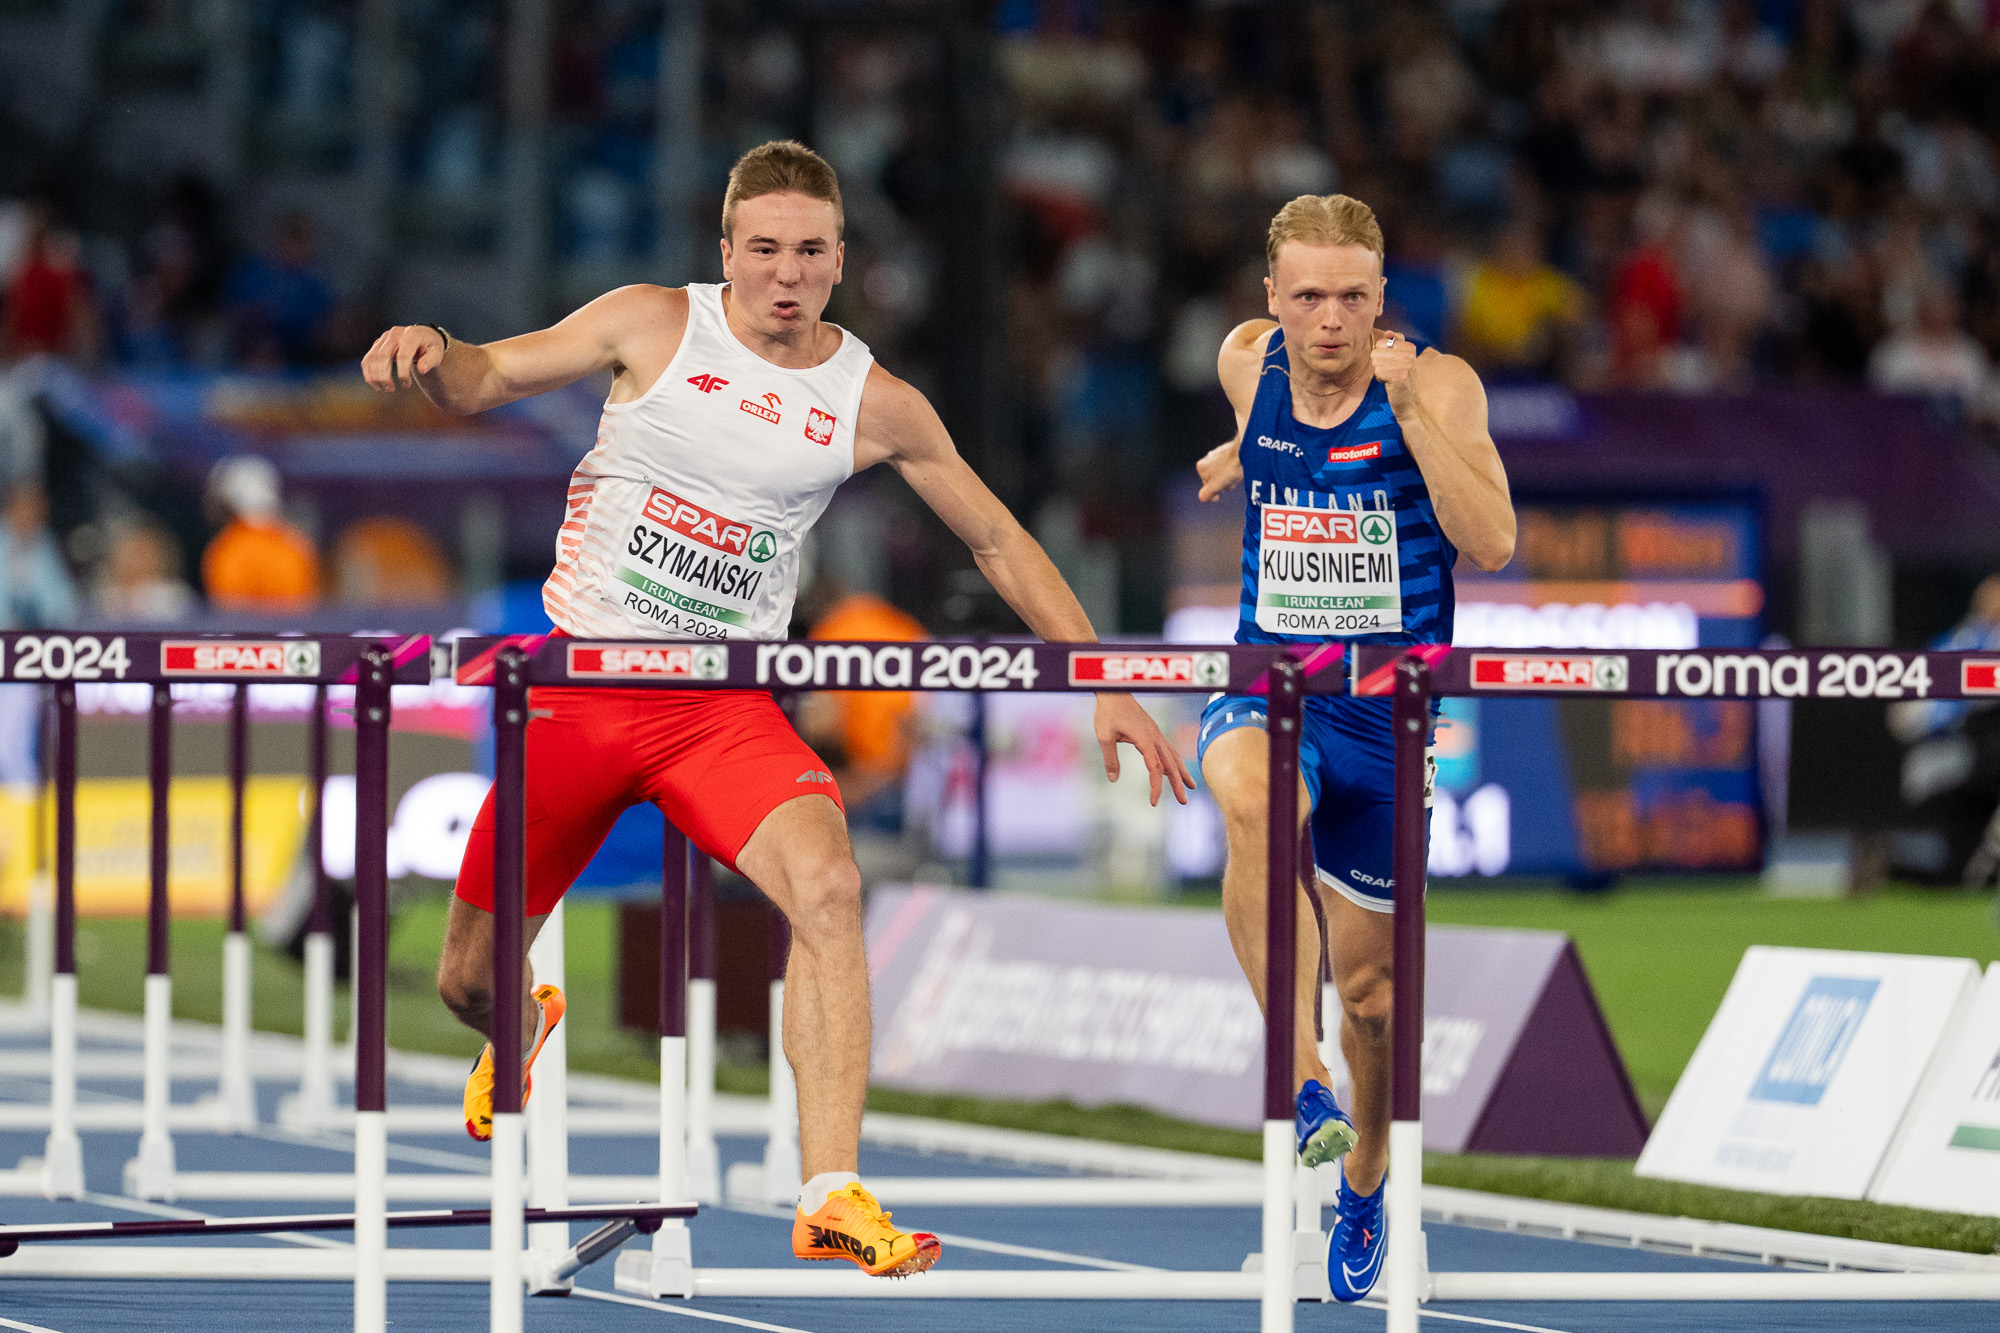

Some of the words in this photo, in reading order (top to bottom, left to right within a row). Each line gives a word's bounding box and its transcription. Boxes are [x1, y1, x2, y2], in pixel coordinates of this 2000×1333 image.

[687, 373, 730, 393] 4F
[742, 402, 780, 423] ORLEN
[1257, 435, 1297, 455] CRAFT
[1330, 445, 1379, 461] motonet
[646, 492, 748, 551] SPAR
[1265, 512, 1356, 540] SPAR
[628, 525, 763, 601] SZYMAŃSKI
[1263, 549, 1393, 583] KUUSINIEMI
[641, 579, 649, 590] I
[648, 583, 679, 605] RUN
[1284, 596, 1290, 607] I
[1290, 596, 1319, 608] RUN
[624, 591, 680, 629] ROMA
[683, 619, 728, 640] 2024
[1277, 613, 1330, 630] ROMA
[1335, 614, 1381, 630] 2024
[14, 635, 131, 679] 2024
[193, 648, 282, 670] SPAR
[600, 650, 691, 673] SPAR
[756, 644, 913, 687] roma
[920, 645, 1039, 690] 2024
[1101, 658, 1191, 681] SPAR
[1502, 660, 1592, 684] SPAR
[1656, 654, 1809, 697] roma
[1817, 653, 1933, 698] 2024
[1202, 710, 1268, 742] FIN
[796, 769, 833, 784] 4F
[1350, 869, 1396, 888] CRAF
[806, 1224, 877, 1266] NITRO
